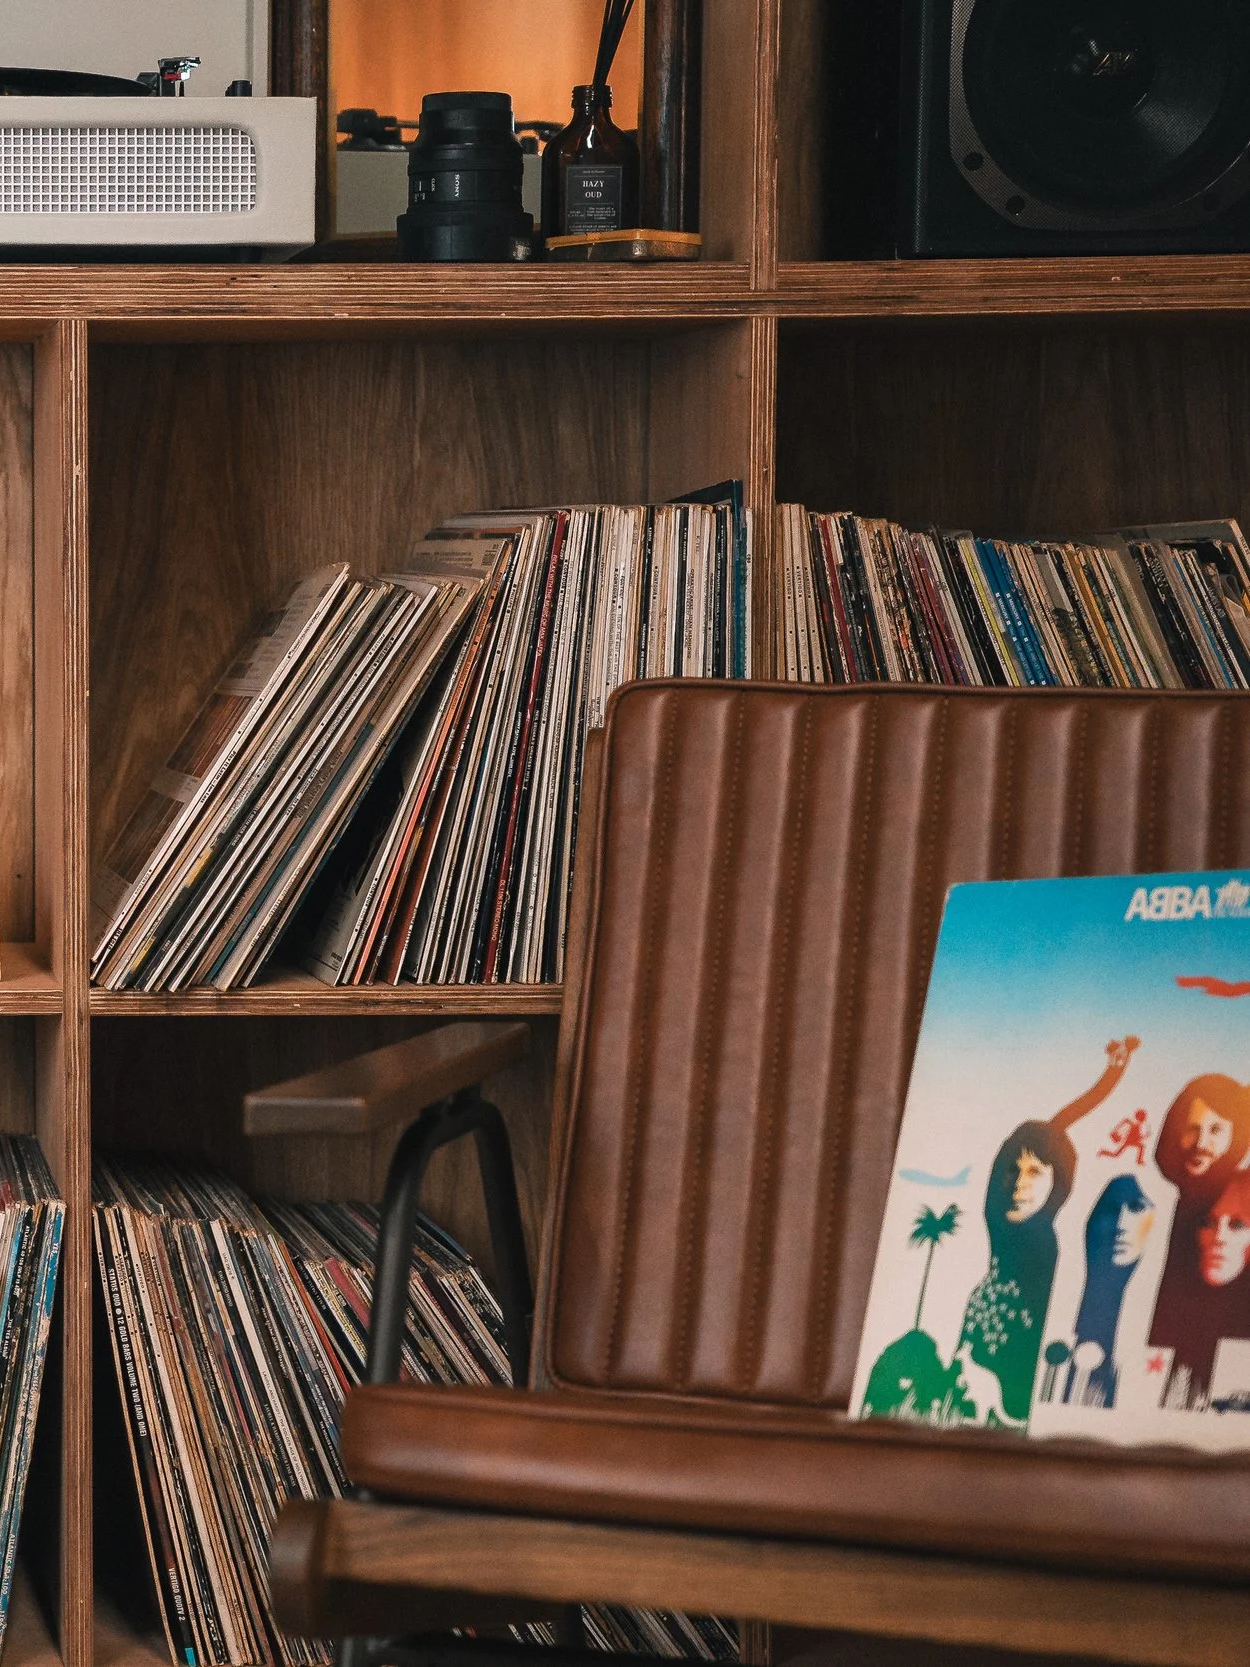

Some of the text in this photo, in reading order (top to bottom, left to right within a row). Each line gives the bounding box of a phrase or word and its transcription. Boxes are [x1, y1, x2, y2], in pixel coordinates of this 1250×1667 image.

[549, 554, 557, 573] RELAX
[506, 588, 516, 608] PHILIPS
[554, 563, 568, 630] CONTOUR DOONICAN
[541, 598, 550, 618] MUSIC
[998, 598, 1008, 619] MERCURY
[1008, 598, 1019, 620] MERCURY
[538, 626, 546, 639] MAX
[540, 618, 547, 626] OF
[371, 632, 385, 652] PHILIPS
[534, 639, 544, 657] JAFFA
[200, 749, 236, 803] Play Latin Loss
[230, 832, 241, 846] SONG
[133, 872, 150, 895] CONTOUR
[499, 879, 506, 888] DL
[363, 882, 376, 907] CONTOUR
[1125, 886, 1211, 921] ABBA
[268, 898, 282, 918] STEREO
[21, 1225, 30, 1249] ATLANTIC
[1, 1339, 9, 1358] ALBUM
[107, 1268, 146, 1436] STATUS QUO 12 GOLD BARS VOLUME TWO (AND ONE)
[262, 1371, 271, 1389] LAUREL
[272, 1399, 280, 1414] HARDY
[281, 1427, 291, 1446] GOLDEN
[294, 1462, 307, 1491] HOLLYWOOD
[263, 1403, 273, 1422] LAUREL
[271, 1426, 280, 1441] HARDY
[277, 1442, 288, 1463] ANOTHER
[321, 1429, 331, 1445] HOLLIES
[329, 1450, 340, 1467] GOLDEN
[5, 1533, 15, 1563] ATLANTIC
[167, 1567, 180, 1593] VERTIGO
[173, 1594, 184, 1615] QUOTV
